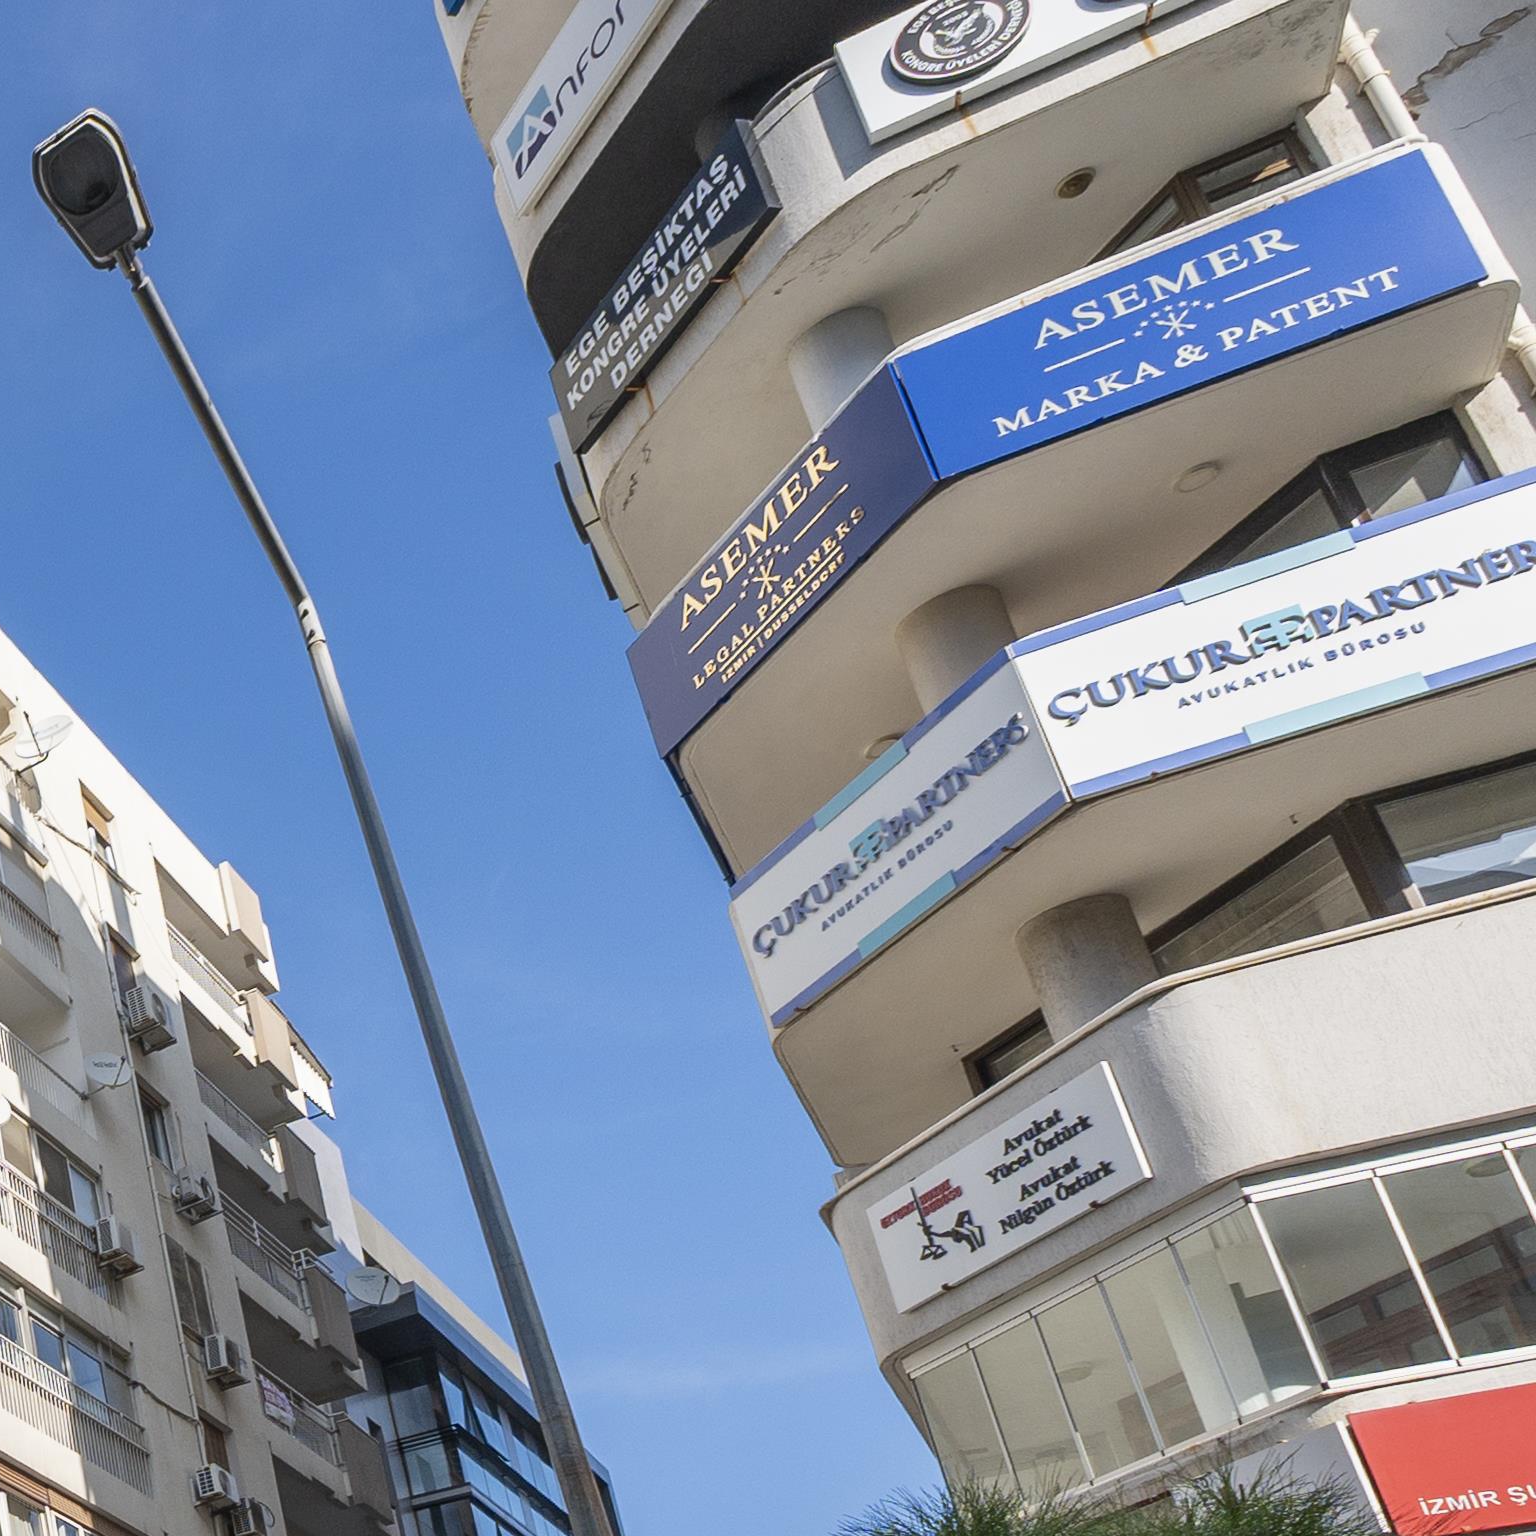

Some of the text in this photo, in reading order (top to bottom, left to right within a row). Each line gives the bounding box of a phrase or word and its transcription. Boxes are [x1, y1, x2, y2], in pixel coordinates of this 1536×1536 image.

[565, 154, 729, 377] EGE BEŞİKTAŞ
[567, 164, 747, 410] KONGRE ÜYELERİ
[610, 246, 714, 390] DERNEĞİ
[1034, 228, 1299, 350] ASEMER
[992, 266, 1399, 437] MARKA & PATENT
[681, 445, 840, 632] ASEMER
[692, 506, 865, 689] LEGAL PARTNERS
[1047, 640, 1252, 726] ÇUKUR
[1178, 621, 1427, 709] AVUKATLIK BÜROSU
[752, 712, 1029, 958] ÇUKUR PARTNERS
[821, 868, 894, 931] AVUKATLIK
[985, 1114, 1094, 1185] Yücel Öztürk
[1003, 1109, 1064, 1156] Avukat
[1019, 1156, 1081, 1201] Avukat
[998, 1160, 1116, 1235] Nilgün Öztürk
[1418, 1489, 1501, 1516] İZMİR
